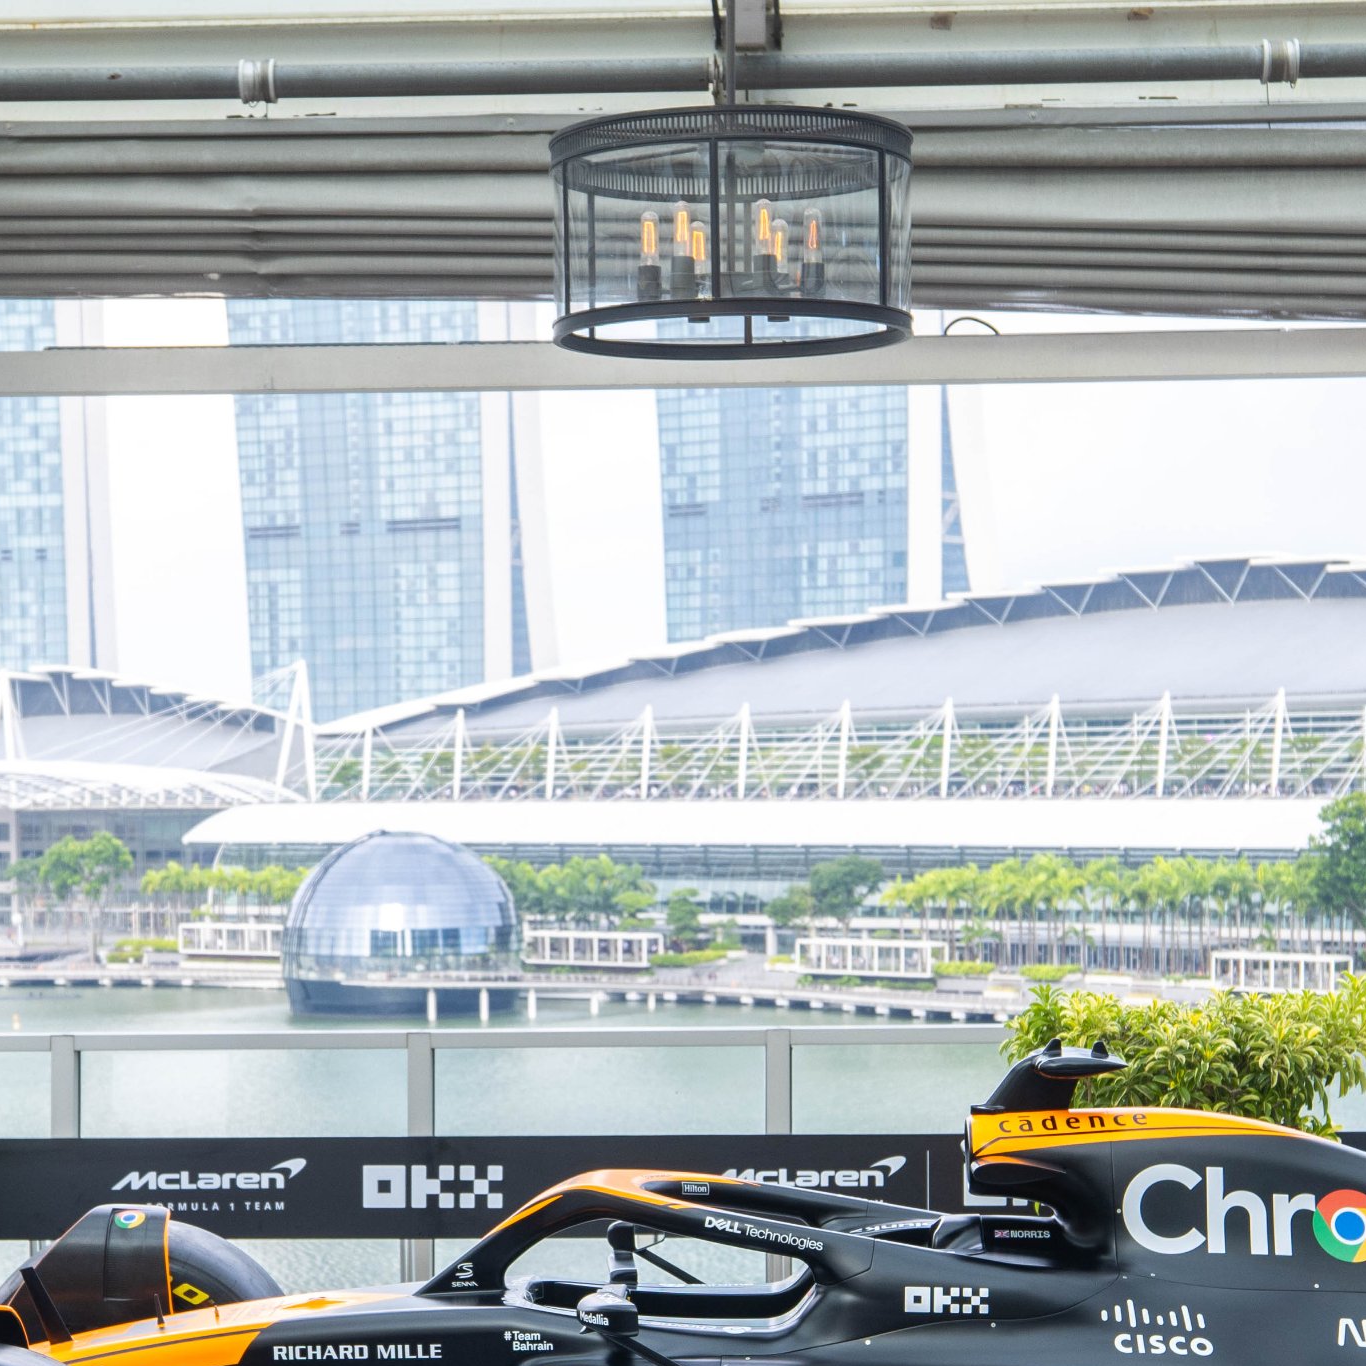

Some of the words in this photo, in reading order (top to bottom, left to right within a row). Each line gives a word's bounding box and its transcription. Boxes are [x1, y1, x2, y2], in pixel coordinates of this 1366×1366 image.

[111, 1171, 285, 1191] McLaren
[363, 1165, 504, 1209] OKX
[684, 1184, 707, 1193] Hilton
[229, 1202, 235, 1211] 1
[245, 1202, 285, 1211] TEAM
[704, 1216, 742, 1235] DELL
[744, 1223, 824, 1251] Technologies
[1010, 1229, 1051, 1240] NORRIS
[905, 1286, 989, 1314] OKX
[579, 1310, 610, 1326] Medallia
[273, 1345, 369, 1361] RICHARD
[377, 1344, 443, 1359] MILLE
[512, 1341, 554, 1351] Bahrain
